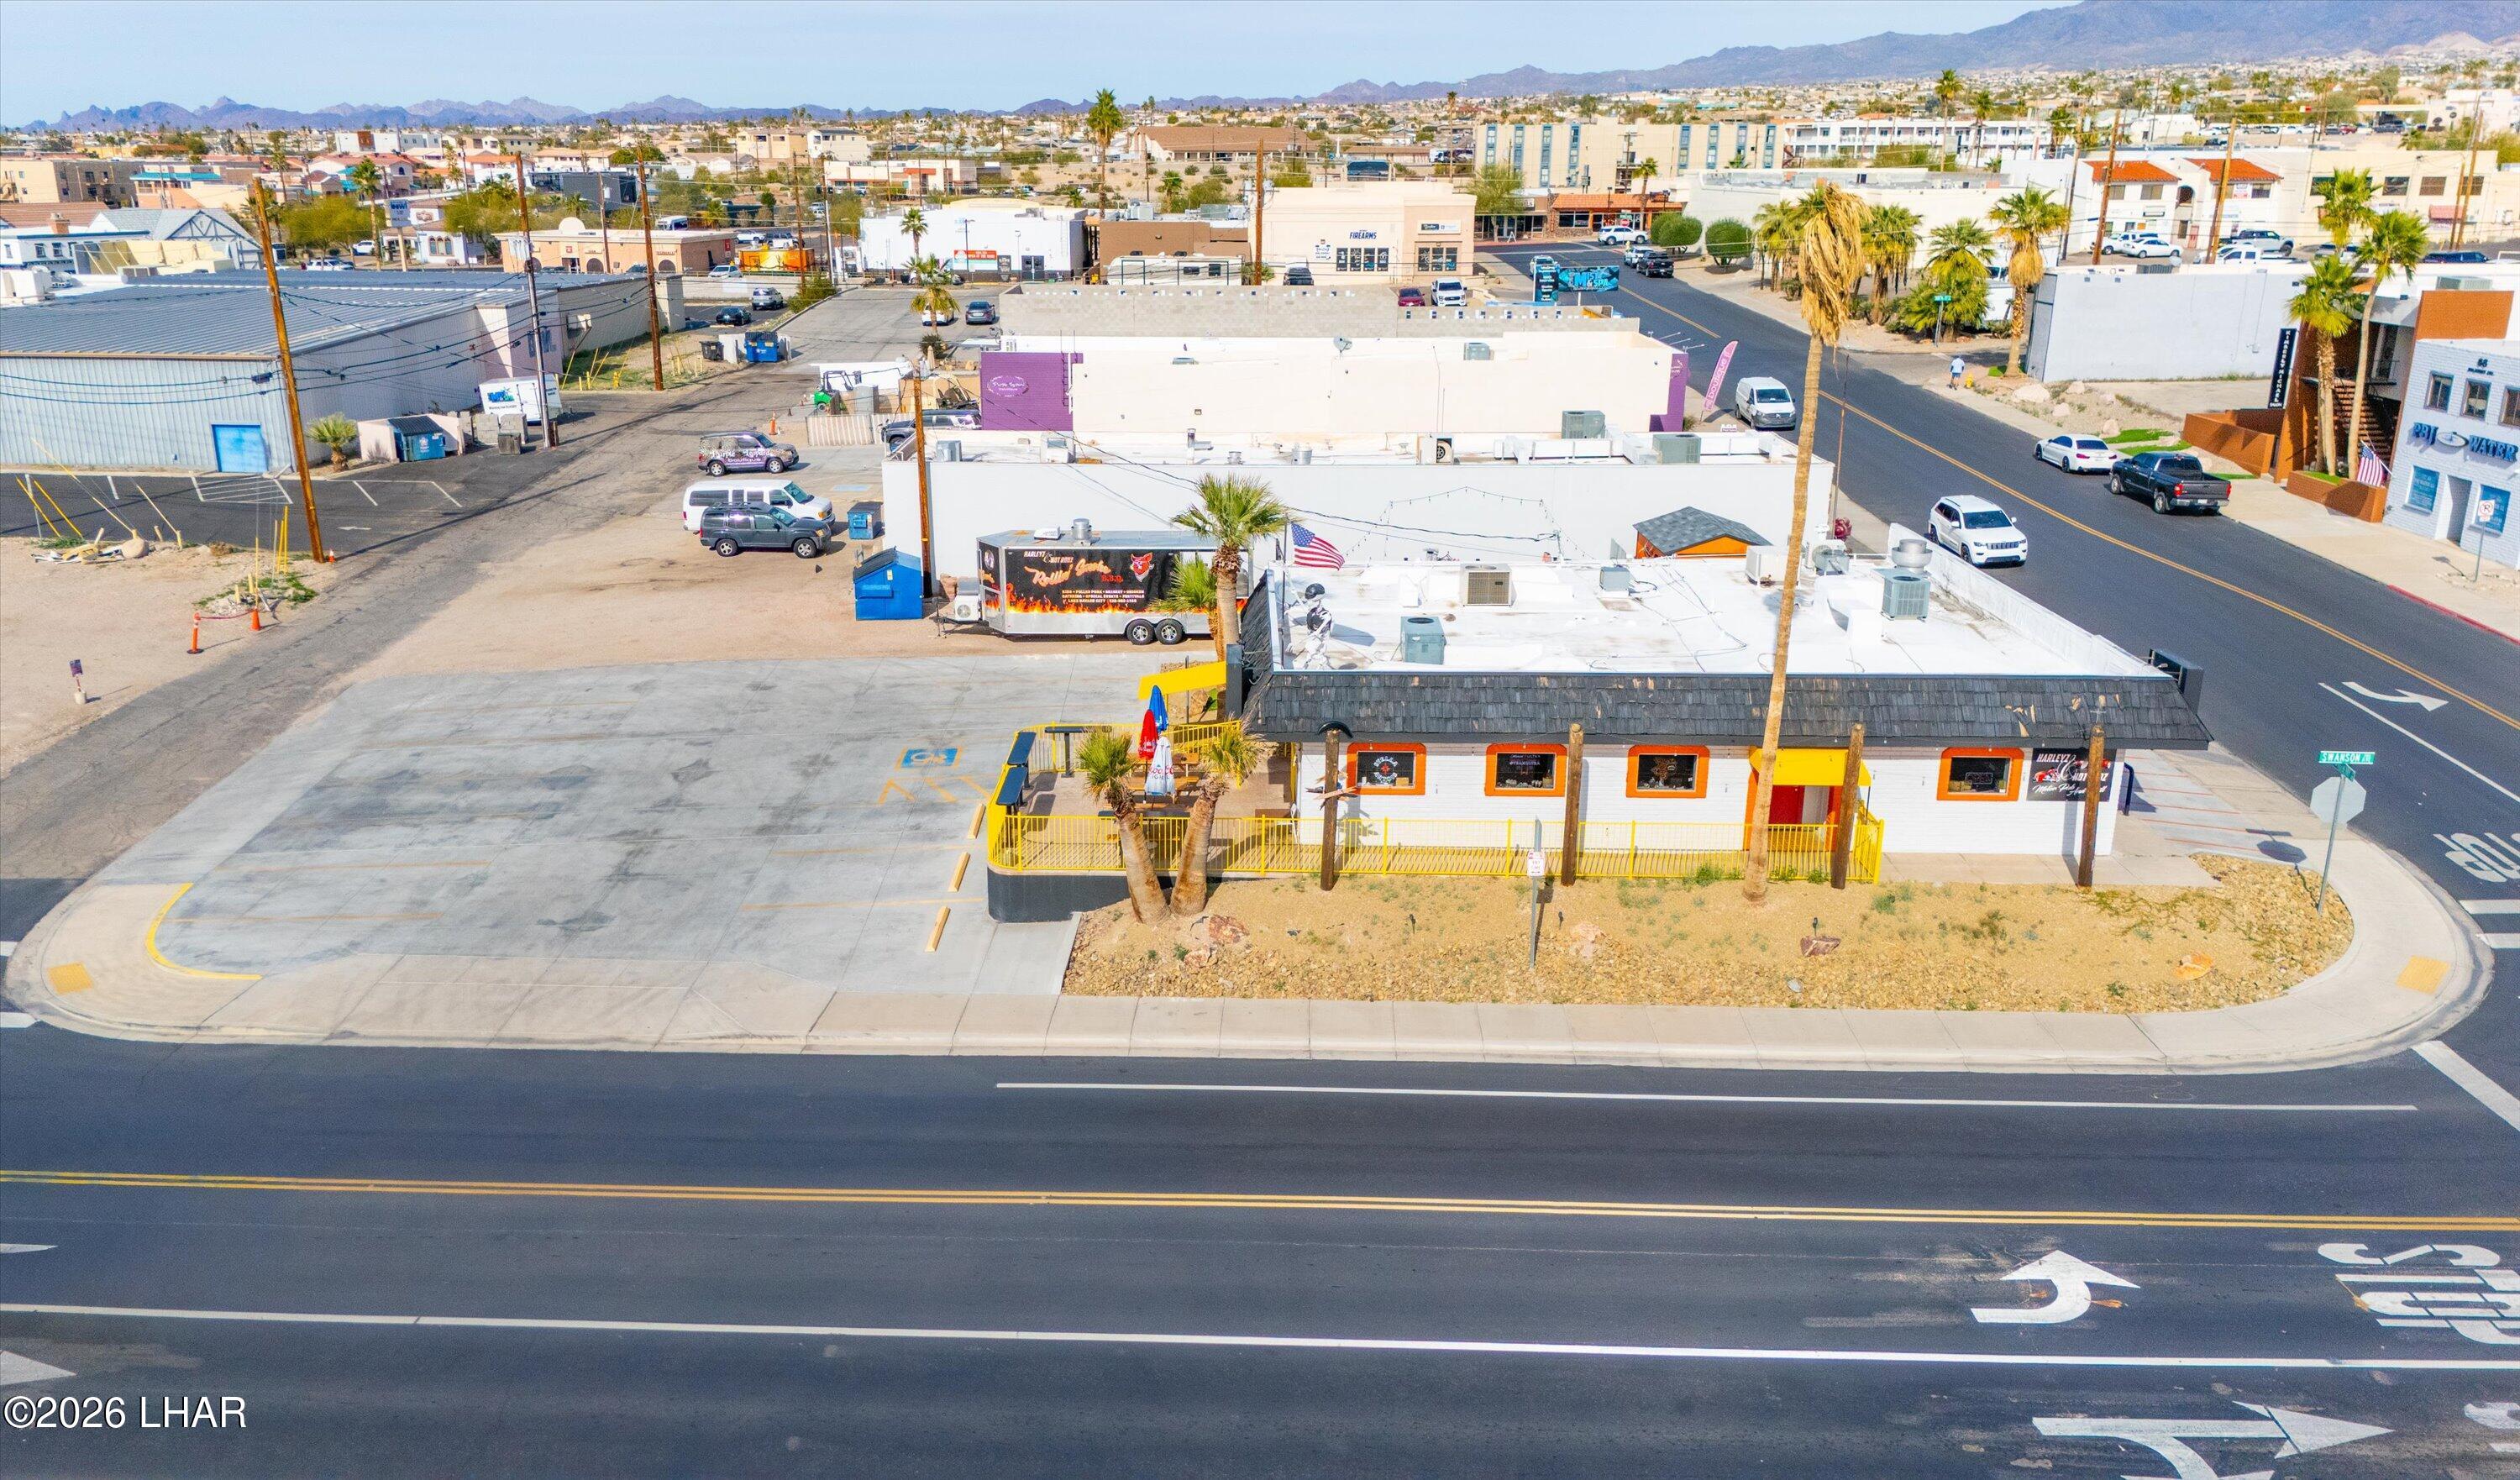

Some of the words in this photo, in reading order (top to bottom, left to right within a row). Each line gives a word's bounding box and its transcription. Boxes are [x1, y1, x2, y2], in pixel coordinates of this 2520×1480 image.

[2280, 330, 2291, 368] KIMBERLY
[1707, 358, 1728, 399] boutique
[2274, 370, 2285, 402] MICHAEL
[2469, 434, 2519, 463] WATER
[2036, 753, 2071, 763] HARLEYZ
[2322, 752, 2360, 763] SWANSON
